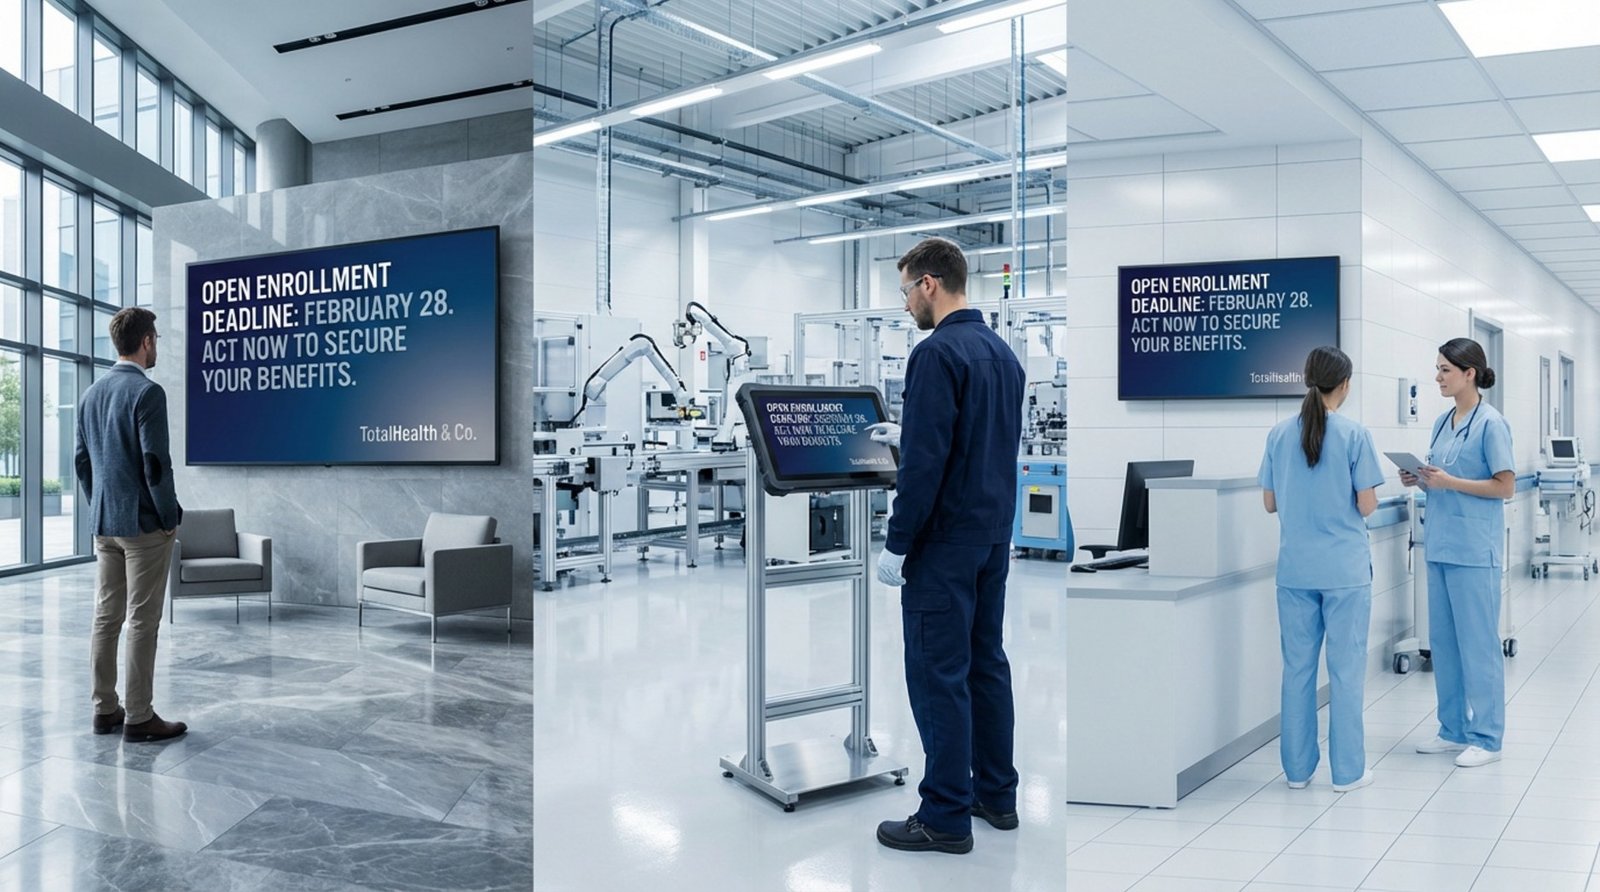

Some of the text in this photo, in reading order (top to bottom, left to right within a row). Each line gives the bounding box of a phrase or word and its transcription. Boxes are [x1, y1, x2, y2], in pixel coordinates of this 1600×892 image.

[202, 261, 392, 305] OPEN ENROLLMENT
[1131, 273, 1270, 294] OPEN ENROLLMENT
[202, 288, 454, 334] DEADLINE: FEBRUARY 28.
[1131, 291, 1313, 313] DEADLINE: FEBRUARY 28.
[1131, 313, 1281, 333] ACT NOW TO SECURE
[202, 325, 407, 363] ACT NOW TO SECURE
[1131, 334, 1247, 353] YOUR BENEFITS.
[202, 361, 357, 393] YOUR BENEFITS.
[359, 423, 477, 442] TotalHealth & Co.
